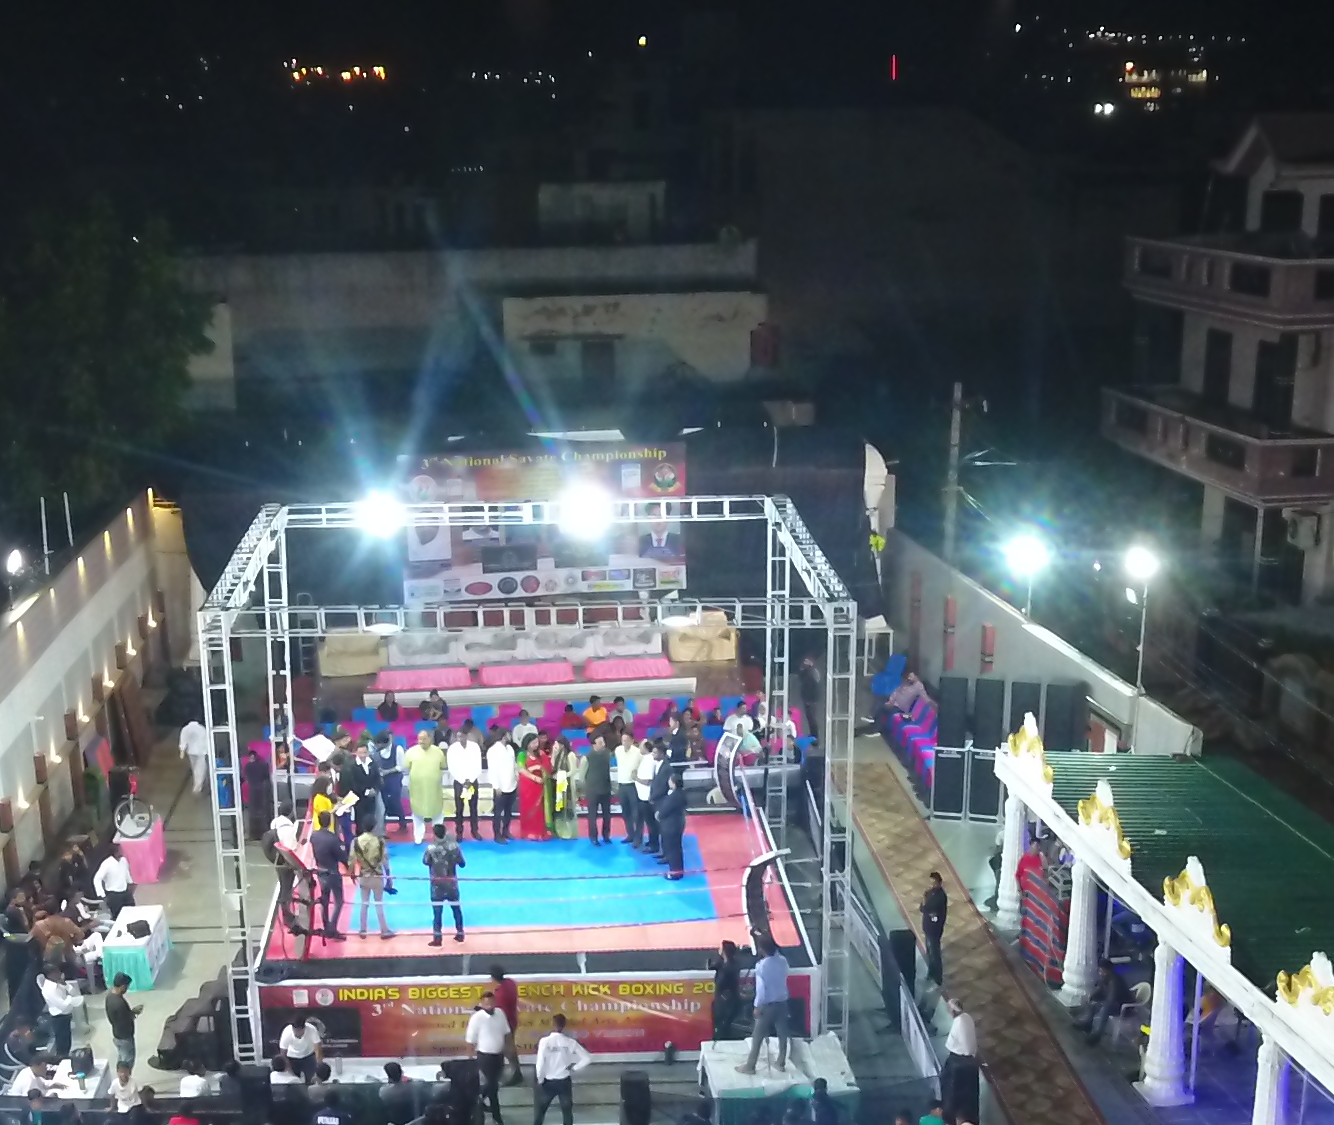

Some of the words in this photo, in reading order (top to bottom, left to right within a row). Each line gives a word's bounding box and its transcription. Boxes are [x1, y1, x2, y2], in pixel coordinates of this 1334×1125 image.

[562, 448, 668, 463] Championship
[338, 985, 400, 1001] INDIA'S
[408, 985, 483, 999] BIGGEST
[517, 984, 564, 998] ENCH
[572, 983, 611, 997] KICK
[618, 982, 684, 996] BOXING
[400, 1002, 467, 1016] Nation
[517, 1001, 553, 1012] vate
[560, 998, 701, 1014] Championship
